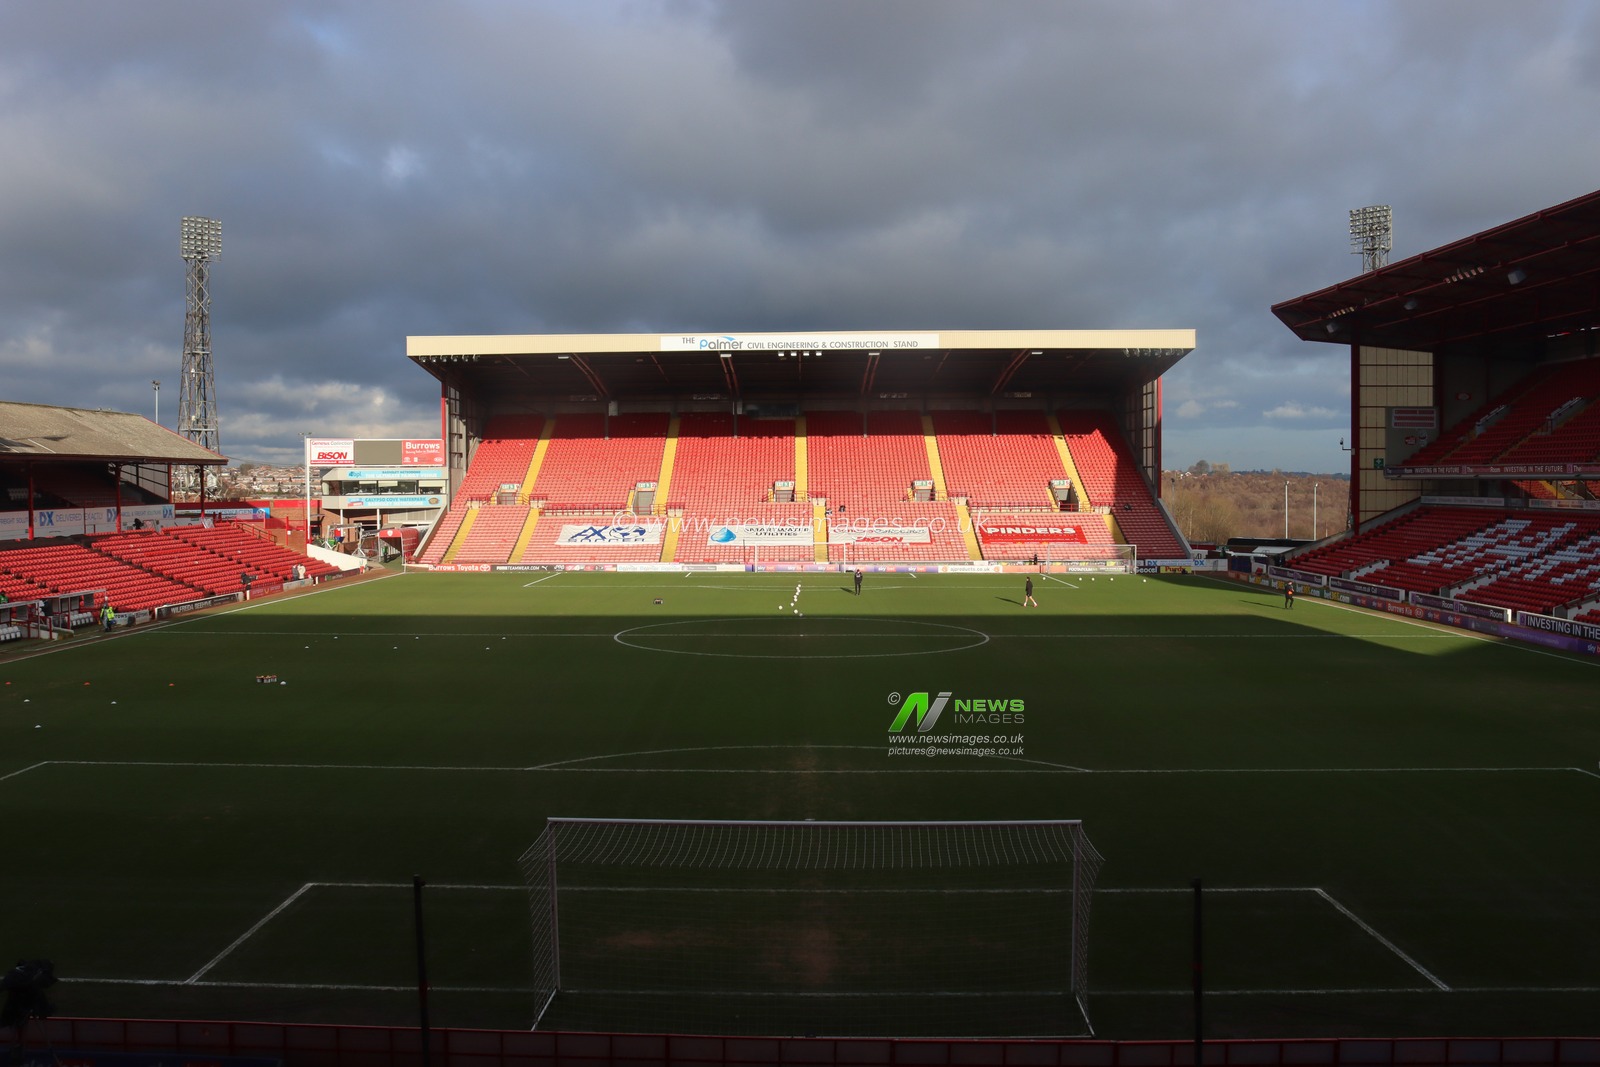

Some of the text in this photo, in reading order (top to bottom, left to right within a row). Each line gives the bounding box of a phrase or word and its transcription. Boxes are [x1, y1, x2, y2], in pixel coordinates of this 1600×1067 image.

[405, 441, 440, 449] Burrows
[56, 513, 81, 522] DELIVERED
[162, 506, 174, 518] DX
[39, 511, 54, 527] DX
[986, 527, 1076, 535] PINDERS
[1324, 589, 1350, 603] bet365.com
[1387, 603, 1404, 614] Burrows
[1441, 601, 1454, 609] Room
[1459, 603, 1468, 611] The
[1489, 609, 1503, 619] Room
[1527, 615, 1571, 634] INVESTING
[1572, 624, 1582, 637] IN
[1583, 626, 1600, 640] THE
[1587, 643, 1596, 654] sky
